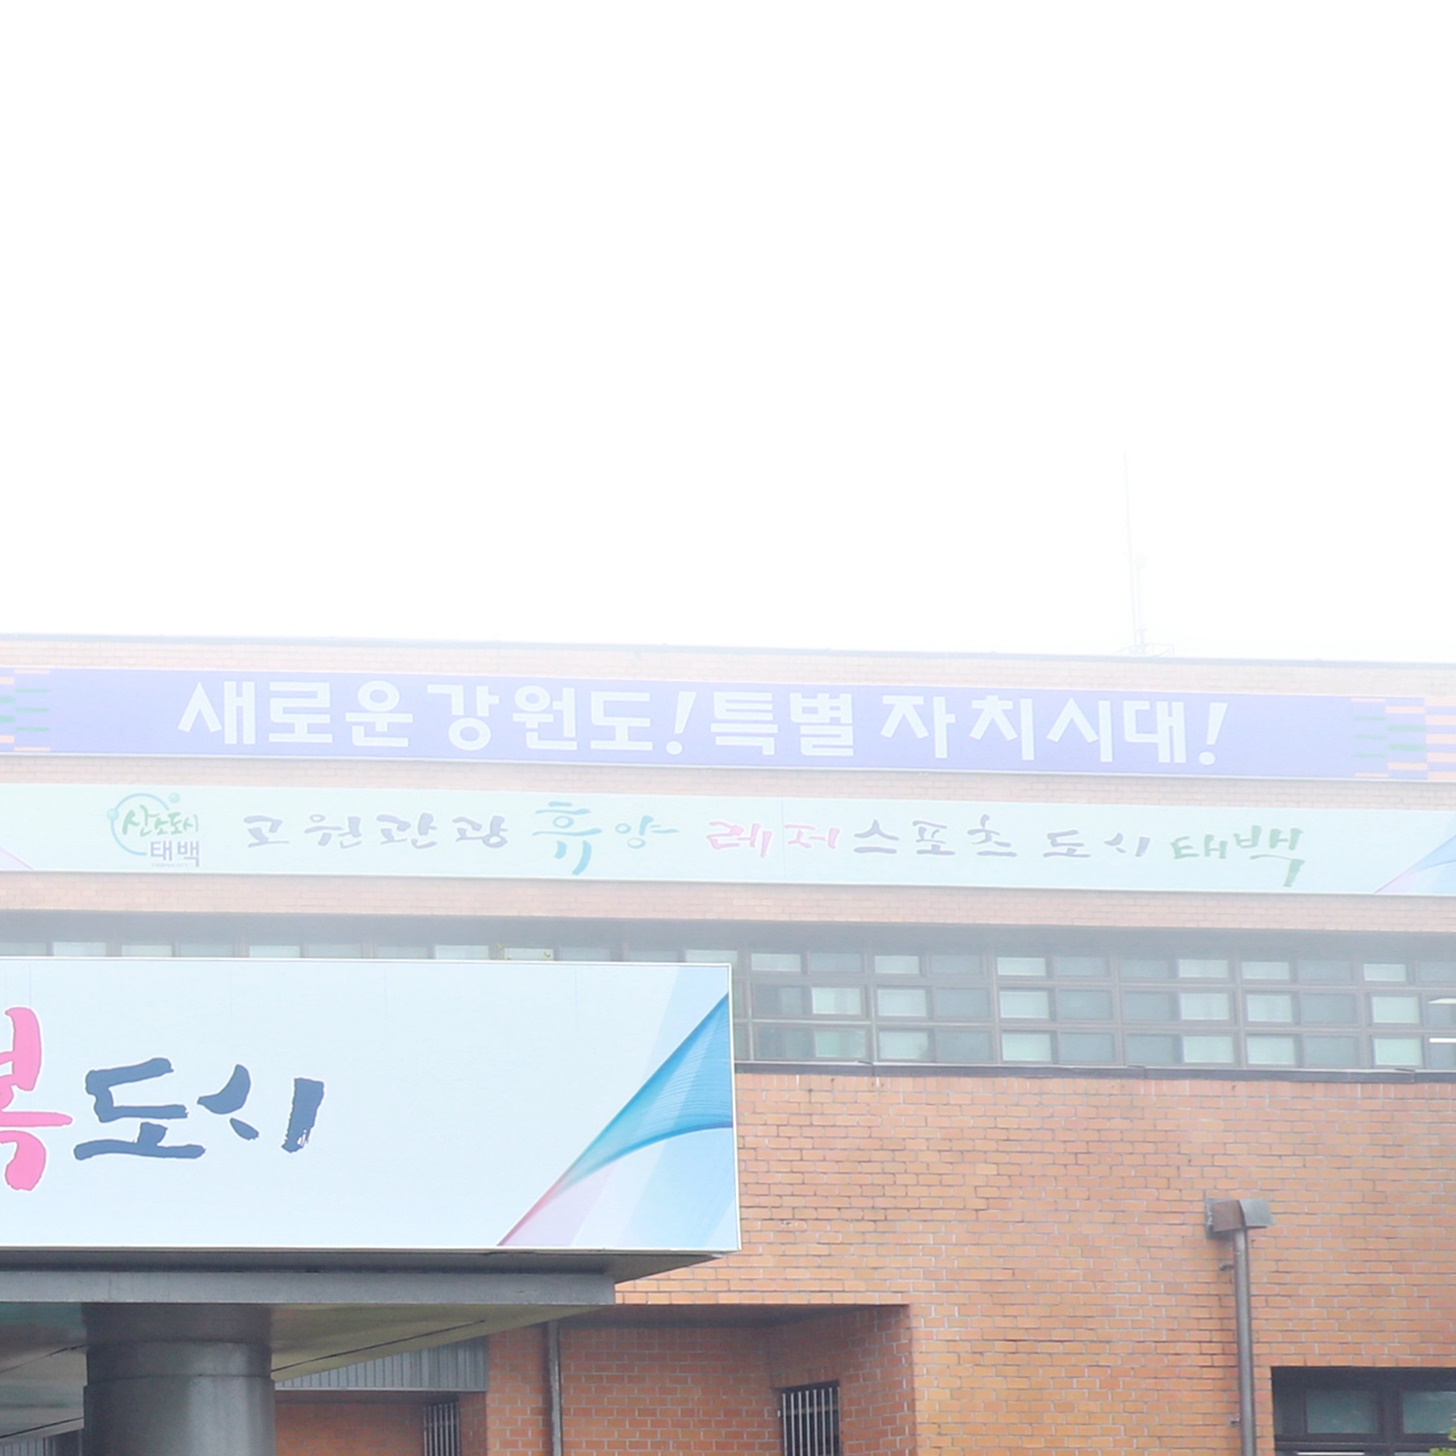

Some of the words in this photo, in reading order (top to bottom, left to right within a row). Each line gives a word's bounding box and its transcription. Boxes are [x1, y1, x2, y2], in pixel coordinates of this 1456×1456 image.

[149, 839, 200, 868] 태백
[243, 813, 509, 850] 고원관광
[1171, 825, 1306, 888] 태백
